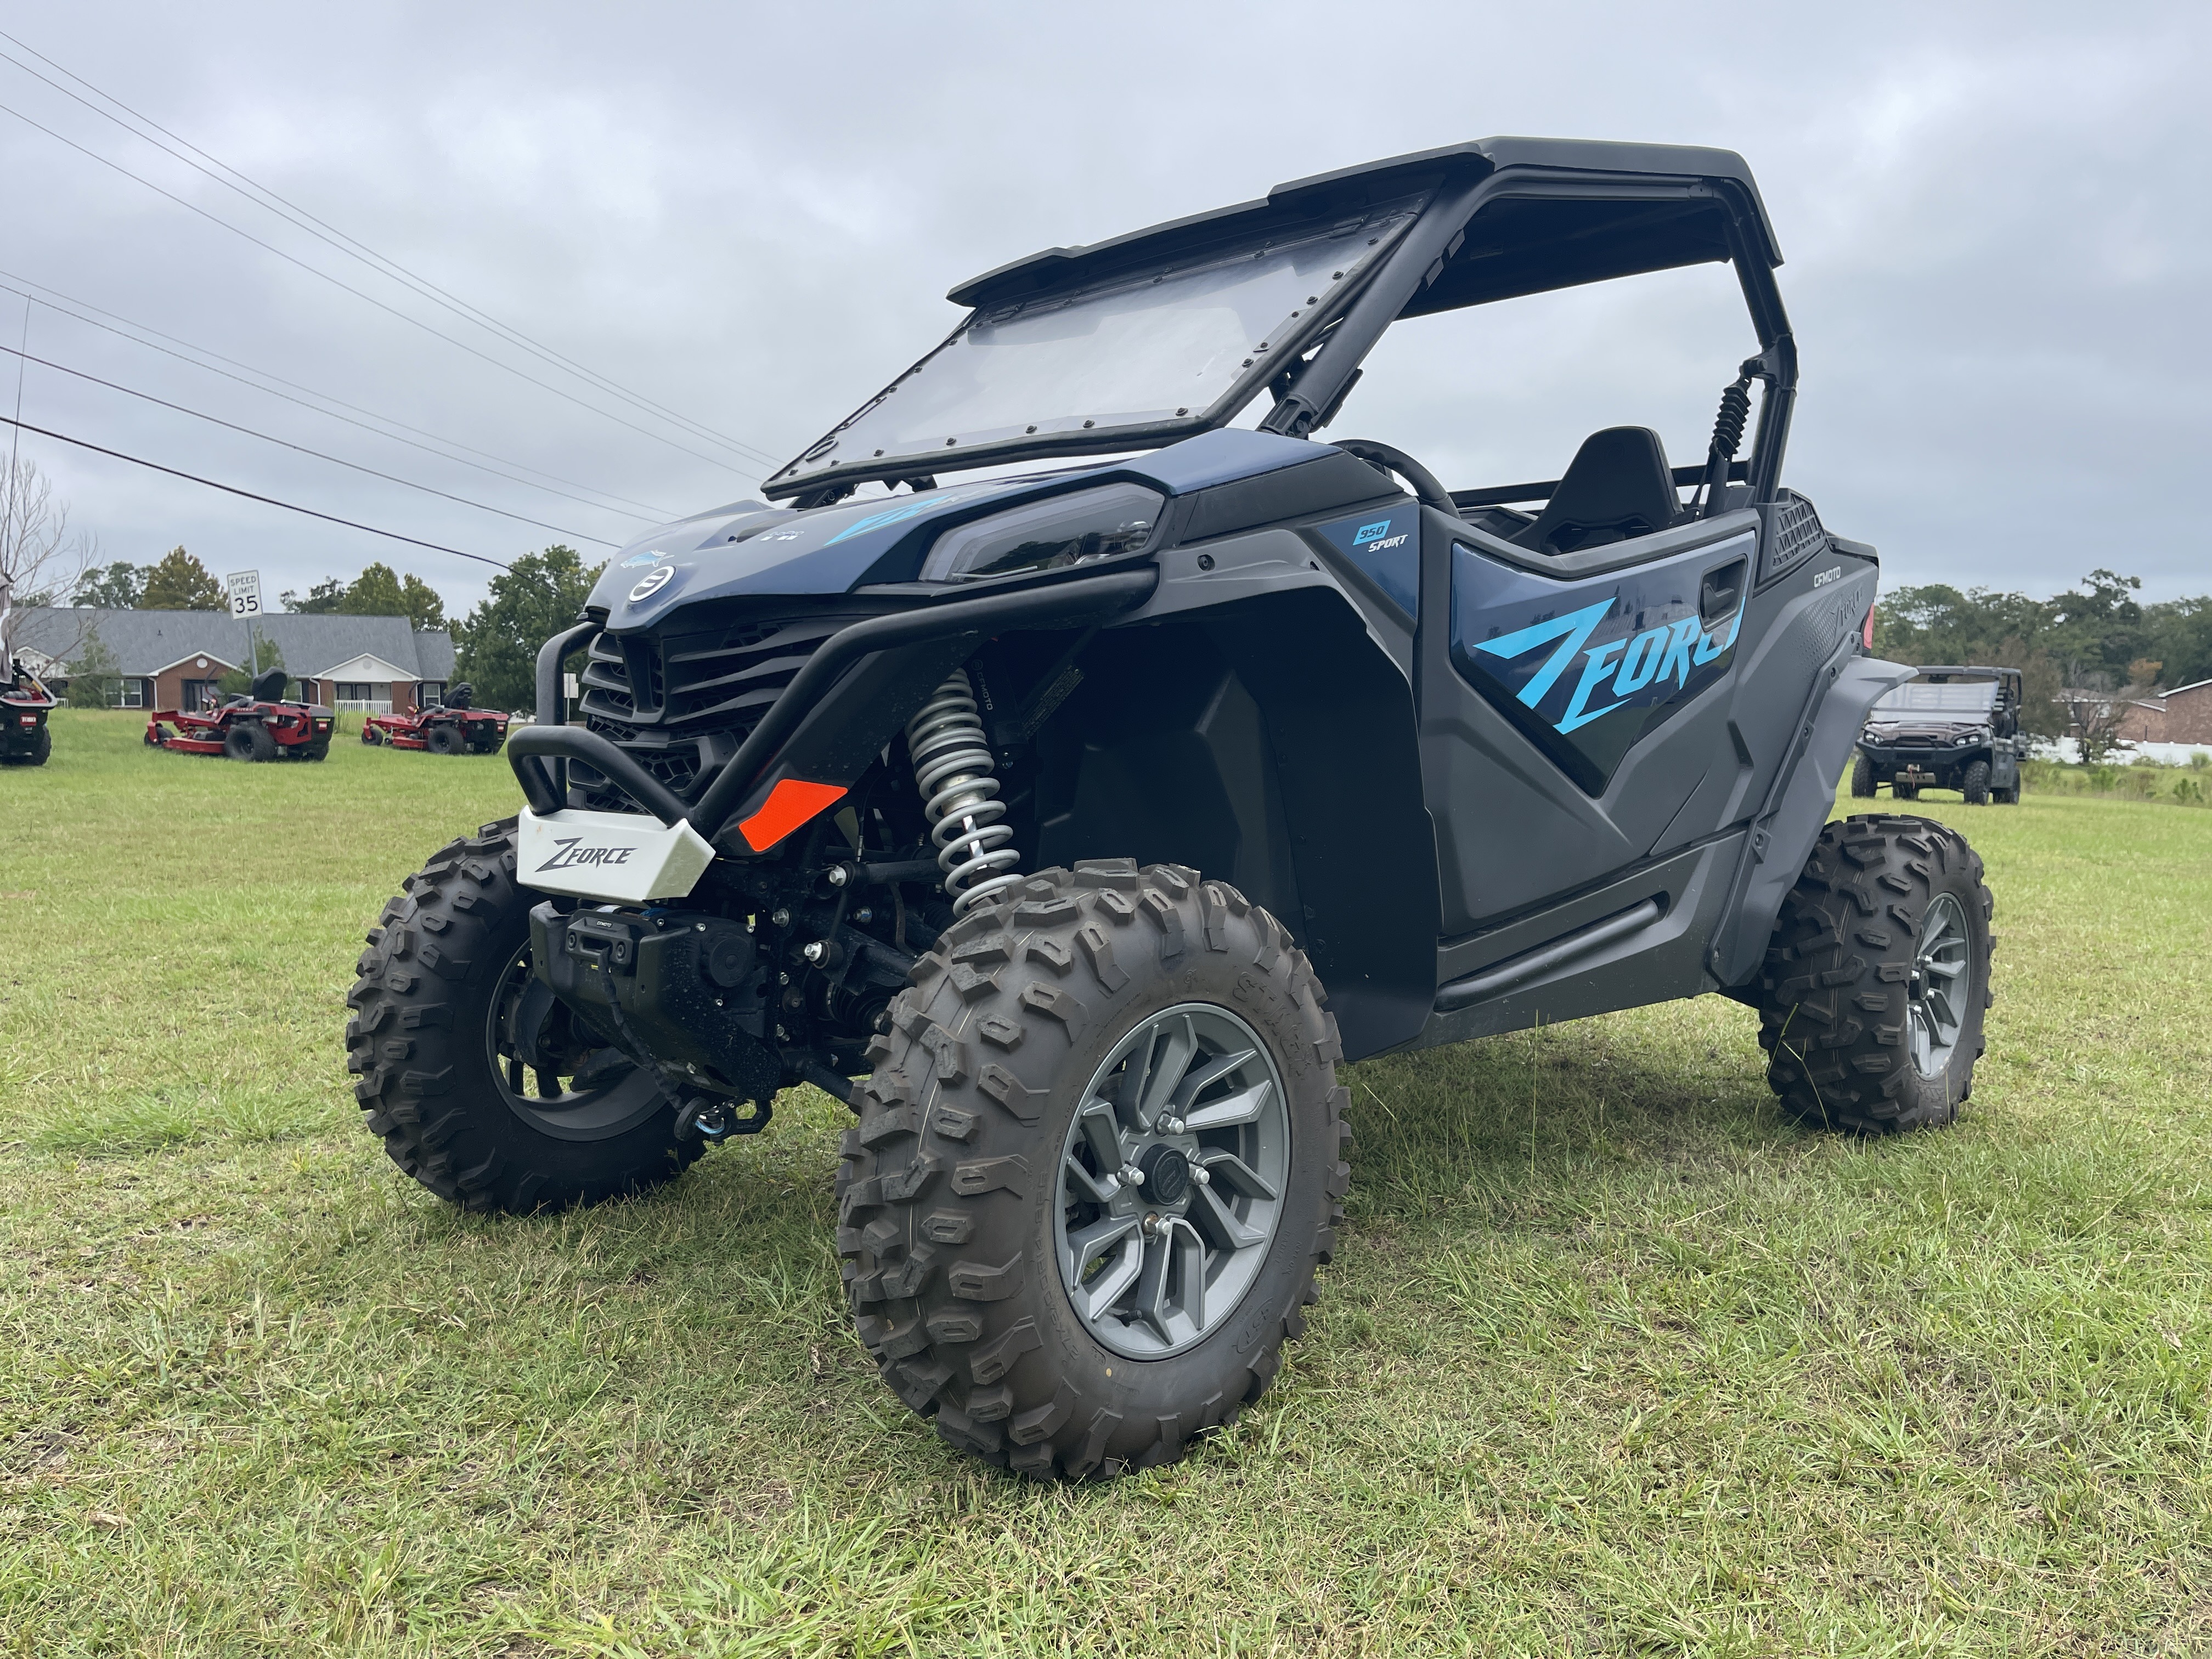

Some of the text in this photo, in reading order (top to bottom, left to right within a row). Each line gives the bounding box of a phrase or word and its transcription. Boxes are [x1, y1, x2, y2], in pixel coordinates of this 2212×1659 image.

[1359, 526, 1385, 539] 950
[1368, 534, 1408, 552] SPORT
[230, 575, 256, 586] SPEED
[1814, 566, 1841, 588] CFMOTO
[234, 585, 254, 595] LIMIT
[235, 595, 258, 613] 35
[977, 672, 993, 710] CFMOTO
[535, 837, 639, 872] ZFORCE
